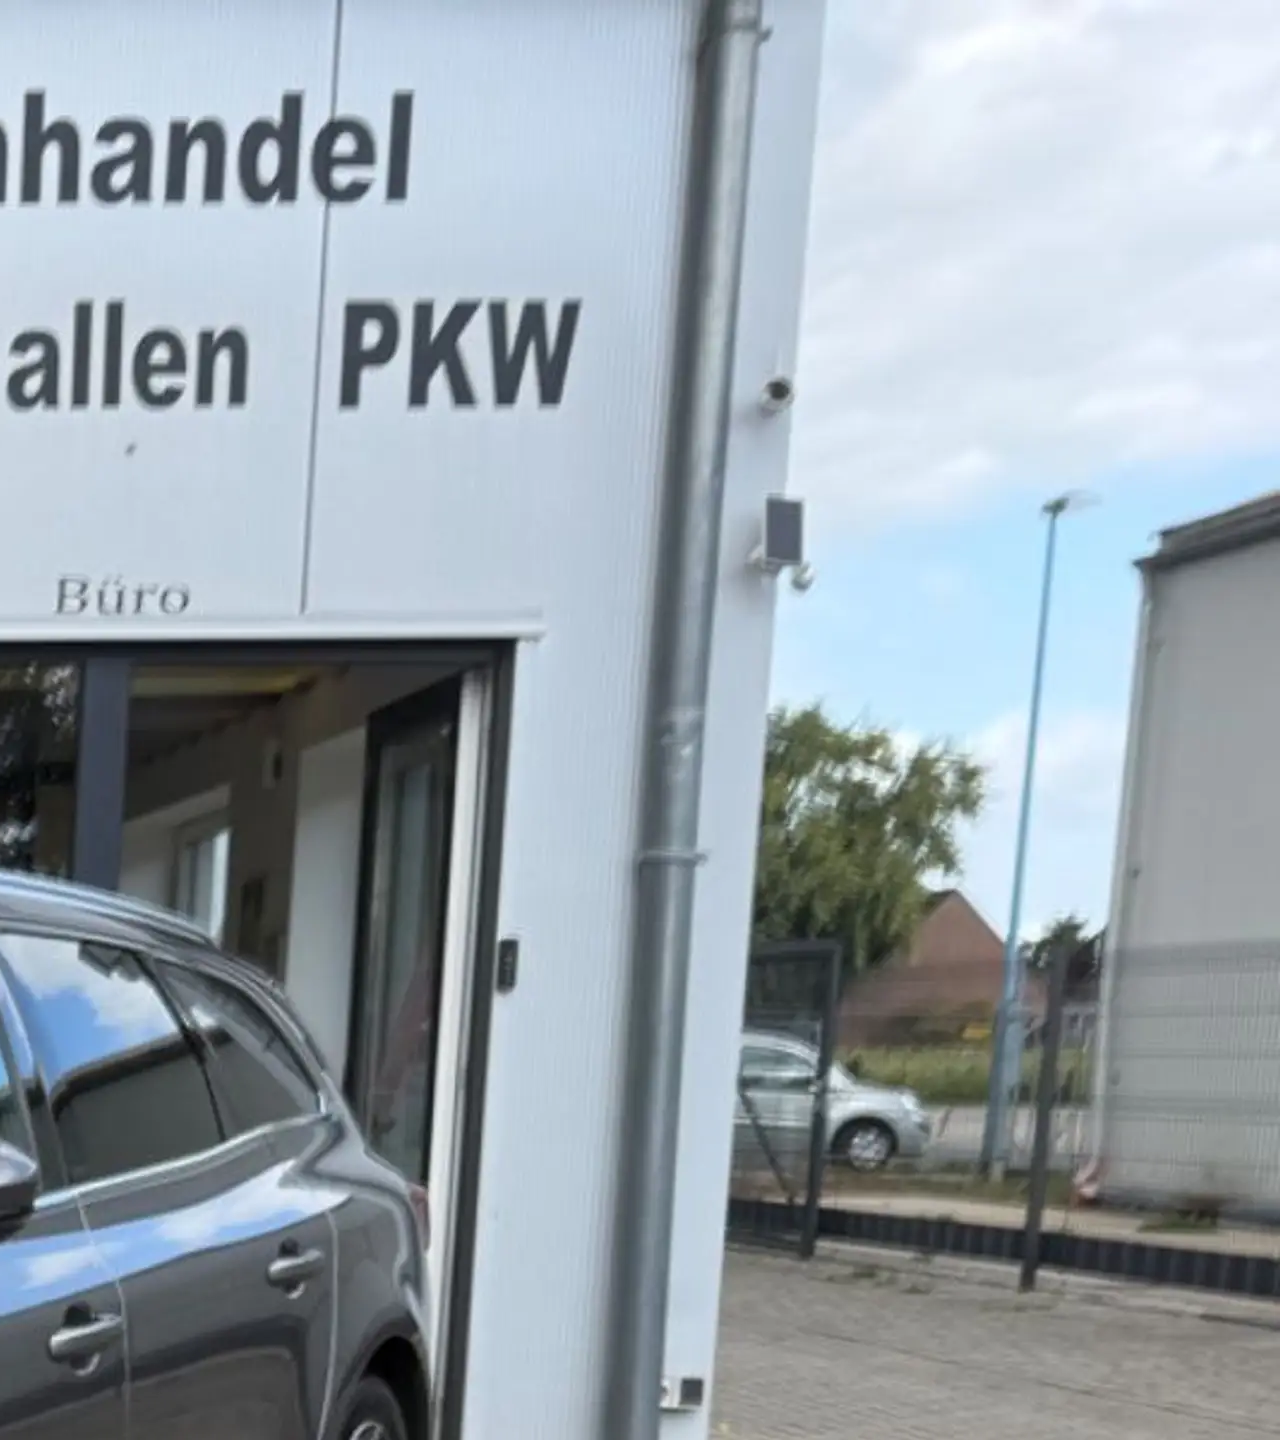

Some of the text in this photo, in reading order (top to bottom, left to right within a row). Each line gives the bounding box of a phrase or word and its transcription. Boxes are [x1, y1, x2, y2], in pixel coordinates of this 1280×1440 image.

[7, 300, 248, 411] allen
[338, 297, 582, 410] PKW
[53, 574, 191, 616] Büro
